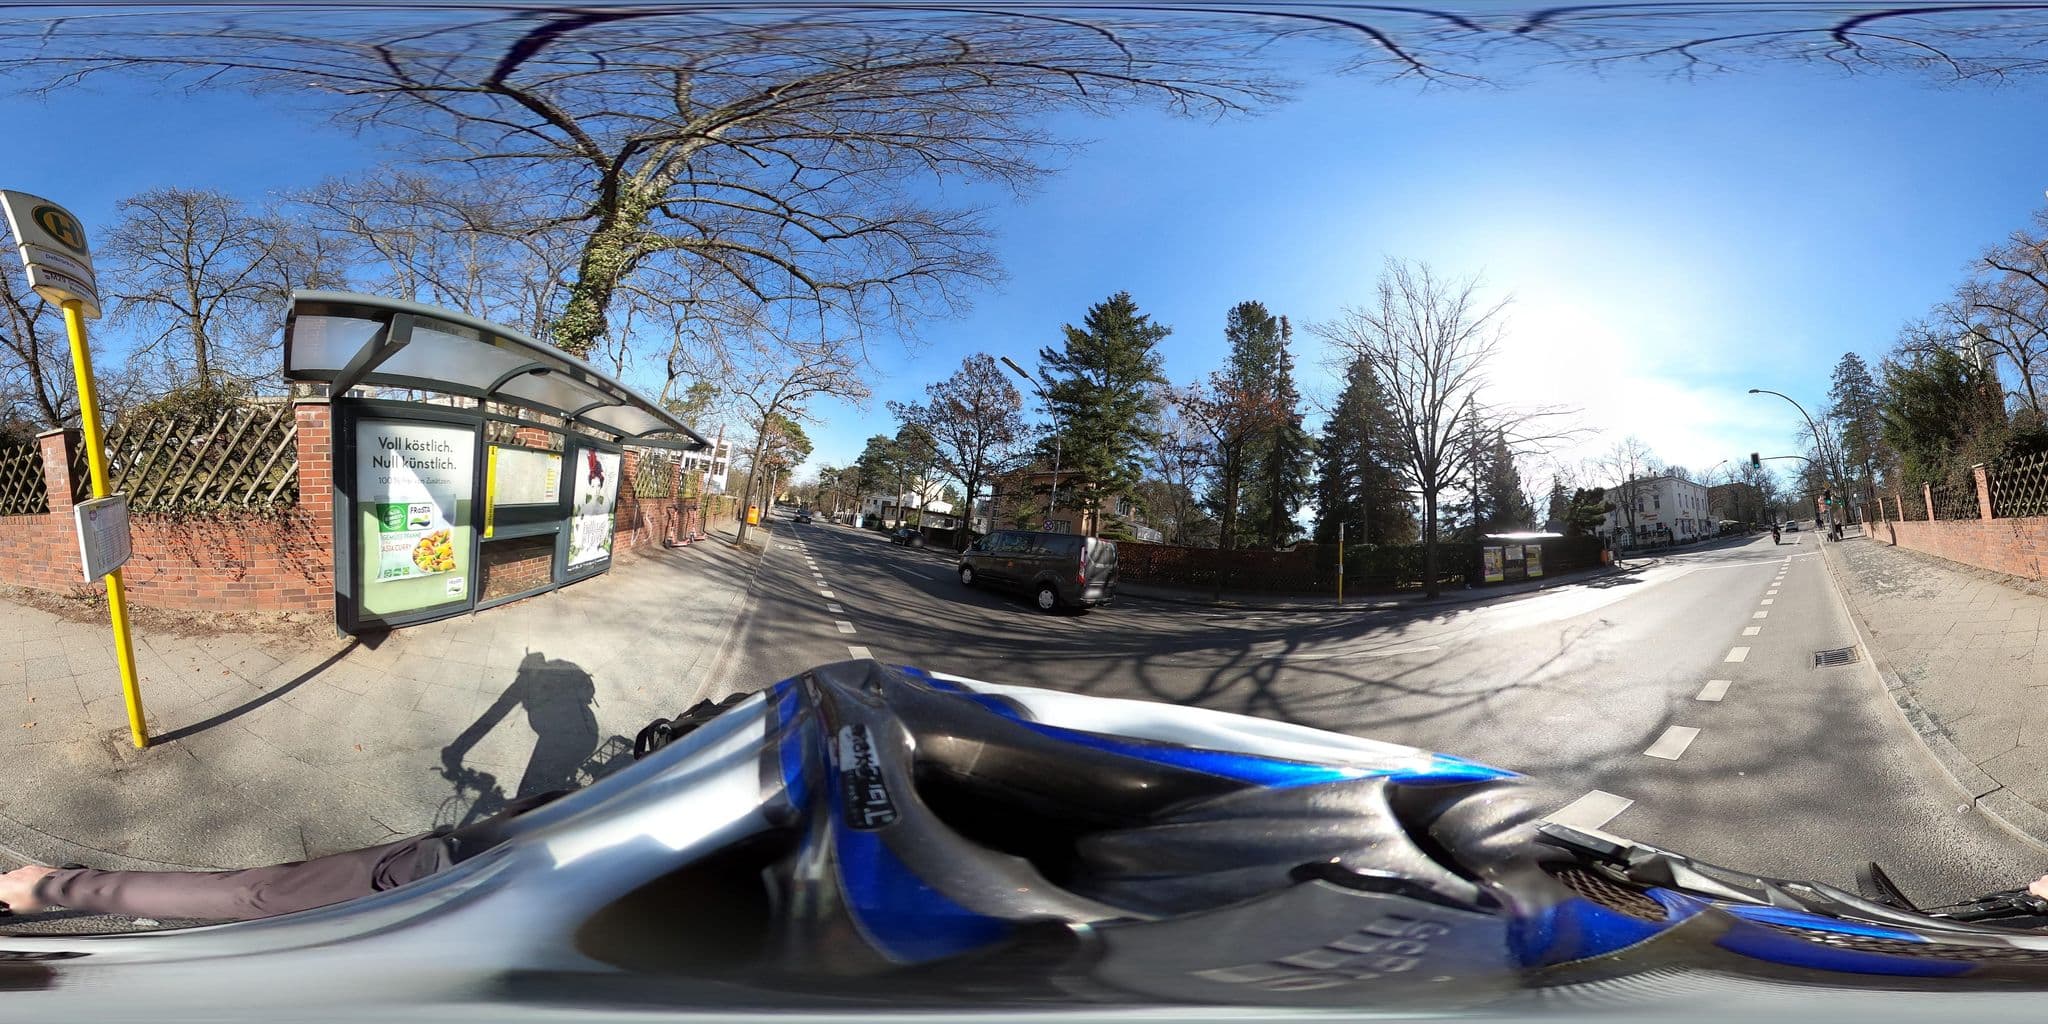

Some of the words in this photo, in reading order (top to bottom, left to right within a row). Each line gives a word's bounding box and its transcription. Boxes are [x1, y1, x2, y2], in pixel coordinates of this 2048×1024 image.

[50, 213, 79, 242] H
[378, 437, 401, 450] Voll
[405, 437, 453, 453] köstlich.
[373, 455, 398, 468] Null
[402, 456, 457, 470] künstlich.
[378, 477, 393, 485] 100
